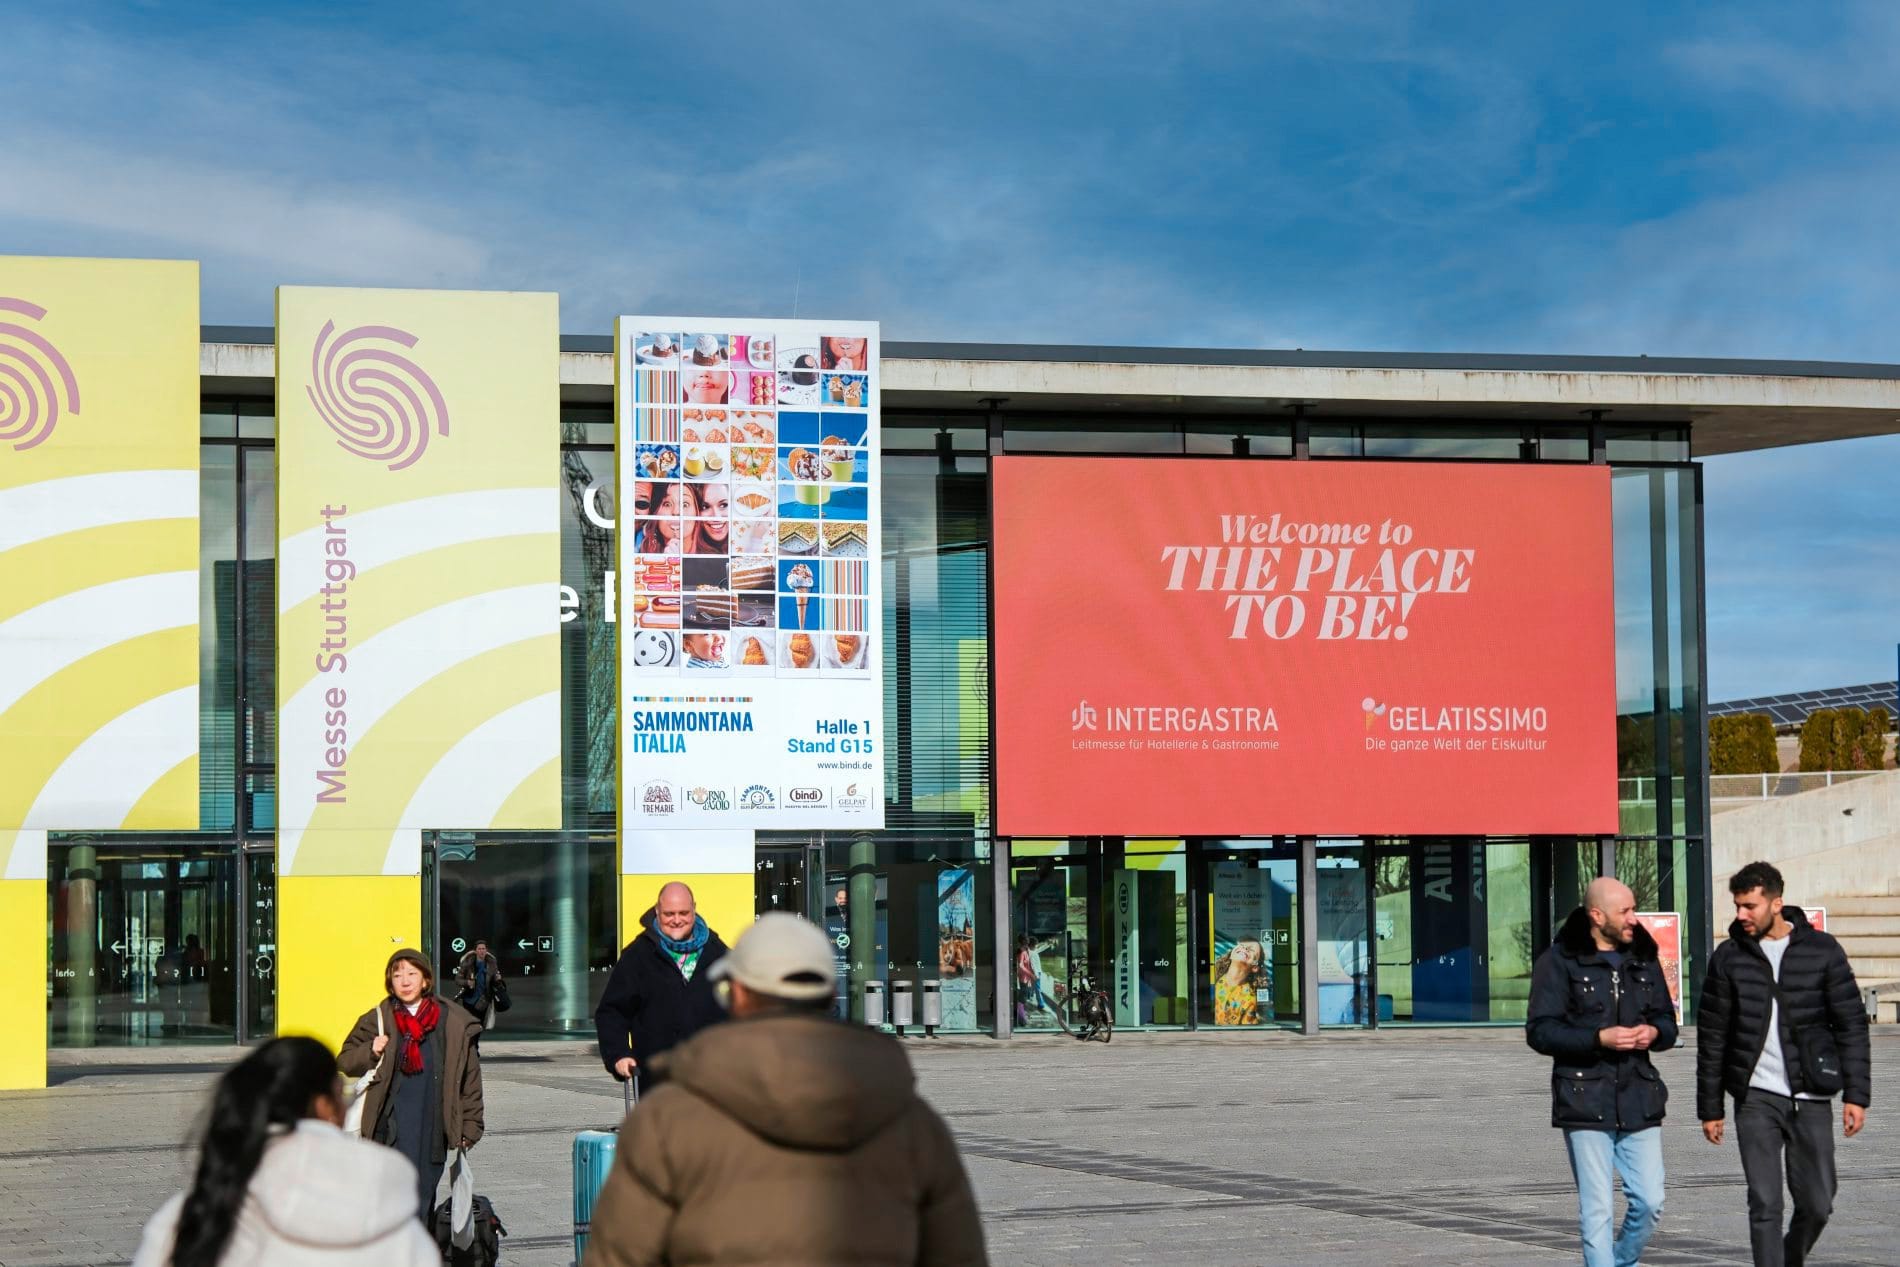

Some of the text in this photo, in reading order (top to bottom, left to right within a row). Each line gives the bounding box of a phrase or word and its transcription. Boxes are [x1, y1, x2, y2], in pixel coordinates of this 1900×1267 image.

[1218, 513, 1413, 545] Welcome to
[1160, 546, 1475, 593] THE PLACE
[1224, 592, 1418, 640] TO BE!
[316, 504, 356, 804] Messe Stuttgart
[633, 711, 753, 732] SAMMONTANA
[816, 719, 871, 735] Halle 1
[1107, 707, 1279, 732] INTERGASTRA
[1389, 707, 1547, 732] GELATISSIMO
[633, 733, 686, 753] ITALIA
[787, 738, 873, 754] Stand G15
[1072, 739, 1279, 750] Leitmesse für Hotellerie & Gastronomie
[1365, 738, 1547, 752] Die ganze Welt der Eiskultur
[817, 761, 873, 770] www.bindi.de
[795, 790, 818, 800] bindi
[1120, 921, 1129, 1010] Allianz
